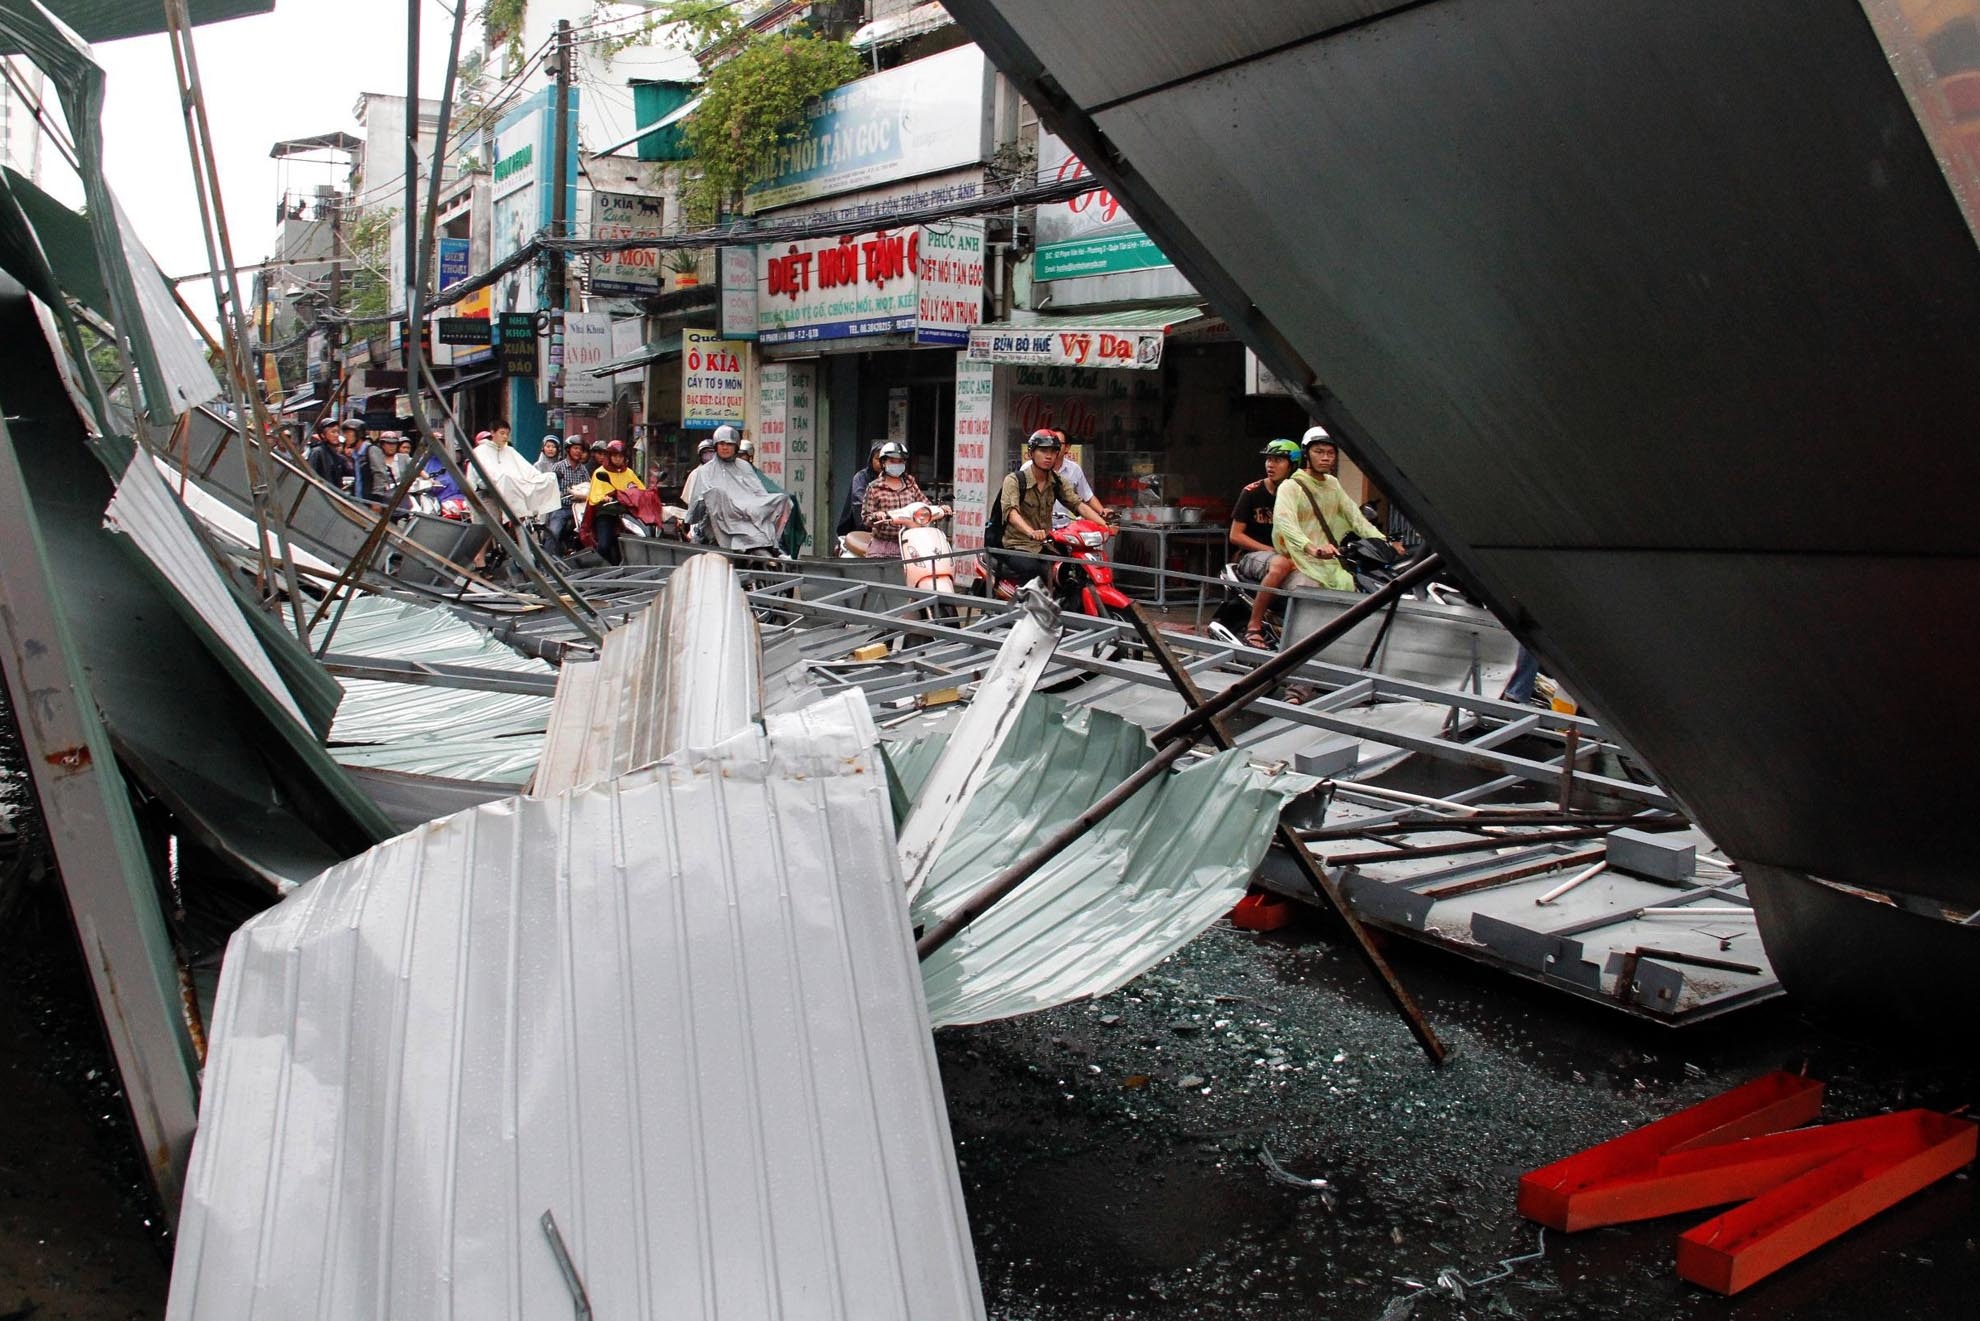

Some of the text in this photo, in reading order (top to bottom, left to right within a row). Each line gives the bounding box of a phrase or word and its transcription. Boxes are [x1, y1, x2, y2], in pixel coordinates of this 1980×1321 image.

[820, 122, 852, 170] TẬN
[856, 108, 891, 156] GỐC
[958, 182, 977, 201] ANH
[600, 194, 609, 208] Ô
[927, 230, 980, 252] PHÚC ANH
[767, 244, 813, 301] DIỆT
[817, 234, 859, 291] MỐI
[862, 230, 905, 290] TẬN
[920, 254, 937, 287] DIỆT
[938, 253, 951, 284] MỐI
[952, 258, 967, 289] TẬN
[968, 256, 983, 287] GỐC
[940, 296, 955, 323] CÔN
[956, 297, 979, 325] TRÙNG
[508, 316, 529, 326] NHA
[586, 323, 605, 335] Khoa
[505, 328, 532, 338] KHOA
[504, 341, 536, 355] XUÂN
[993, 333, 1013, 352] BÚN
[1015, 333, 1030, 352] BÒ
[1032, 332, 1055, 353] HUẾ
[1058, 333, 1092, 365] Vỹ
[1097, 333, 1134, 365] Dạ
[687, 346, 702, 371] Ô
[717, 378, 723, 389] 9
[975, 379, 991, 395] ANH
[793, 391, 809, 409] MỐI
[792, 415, 808, 432] TẬN
[792, 436, 808, 453] GỐC
